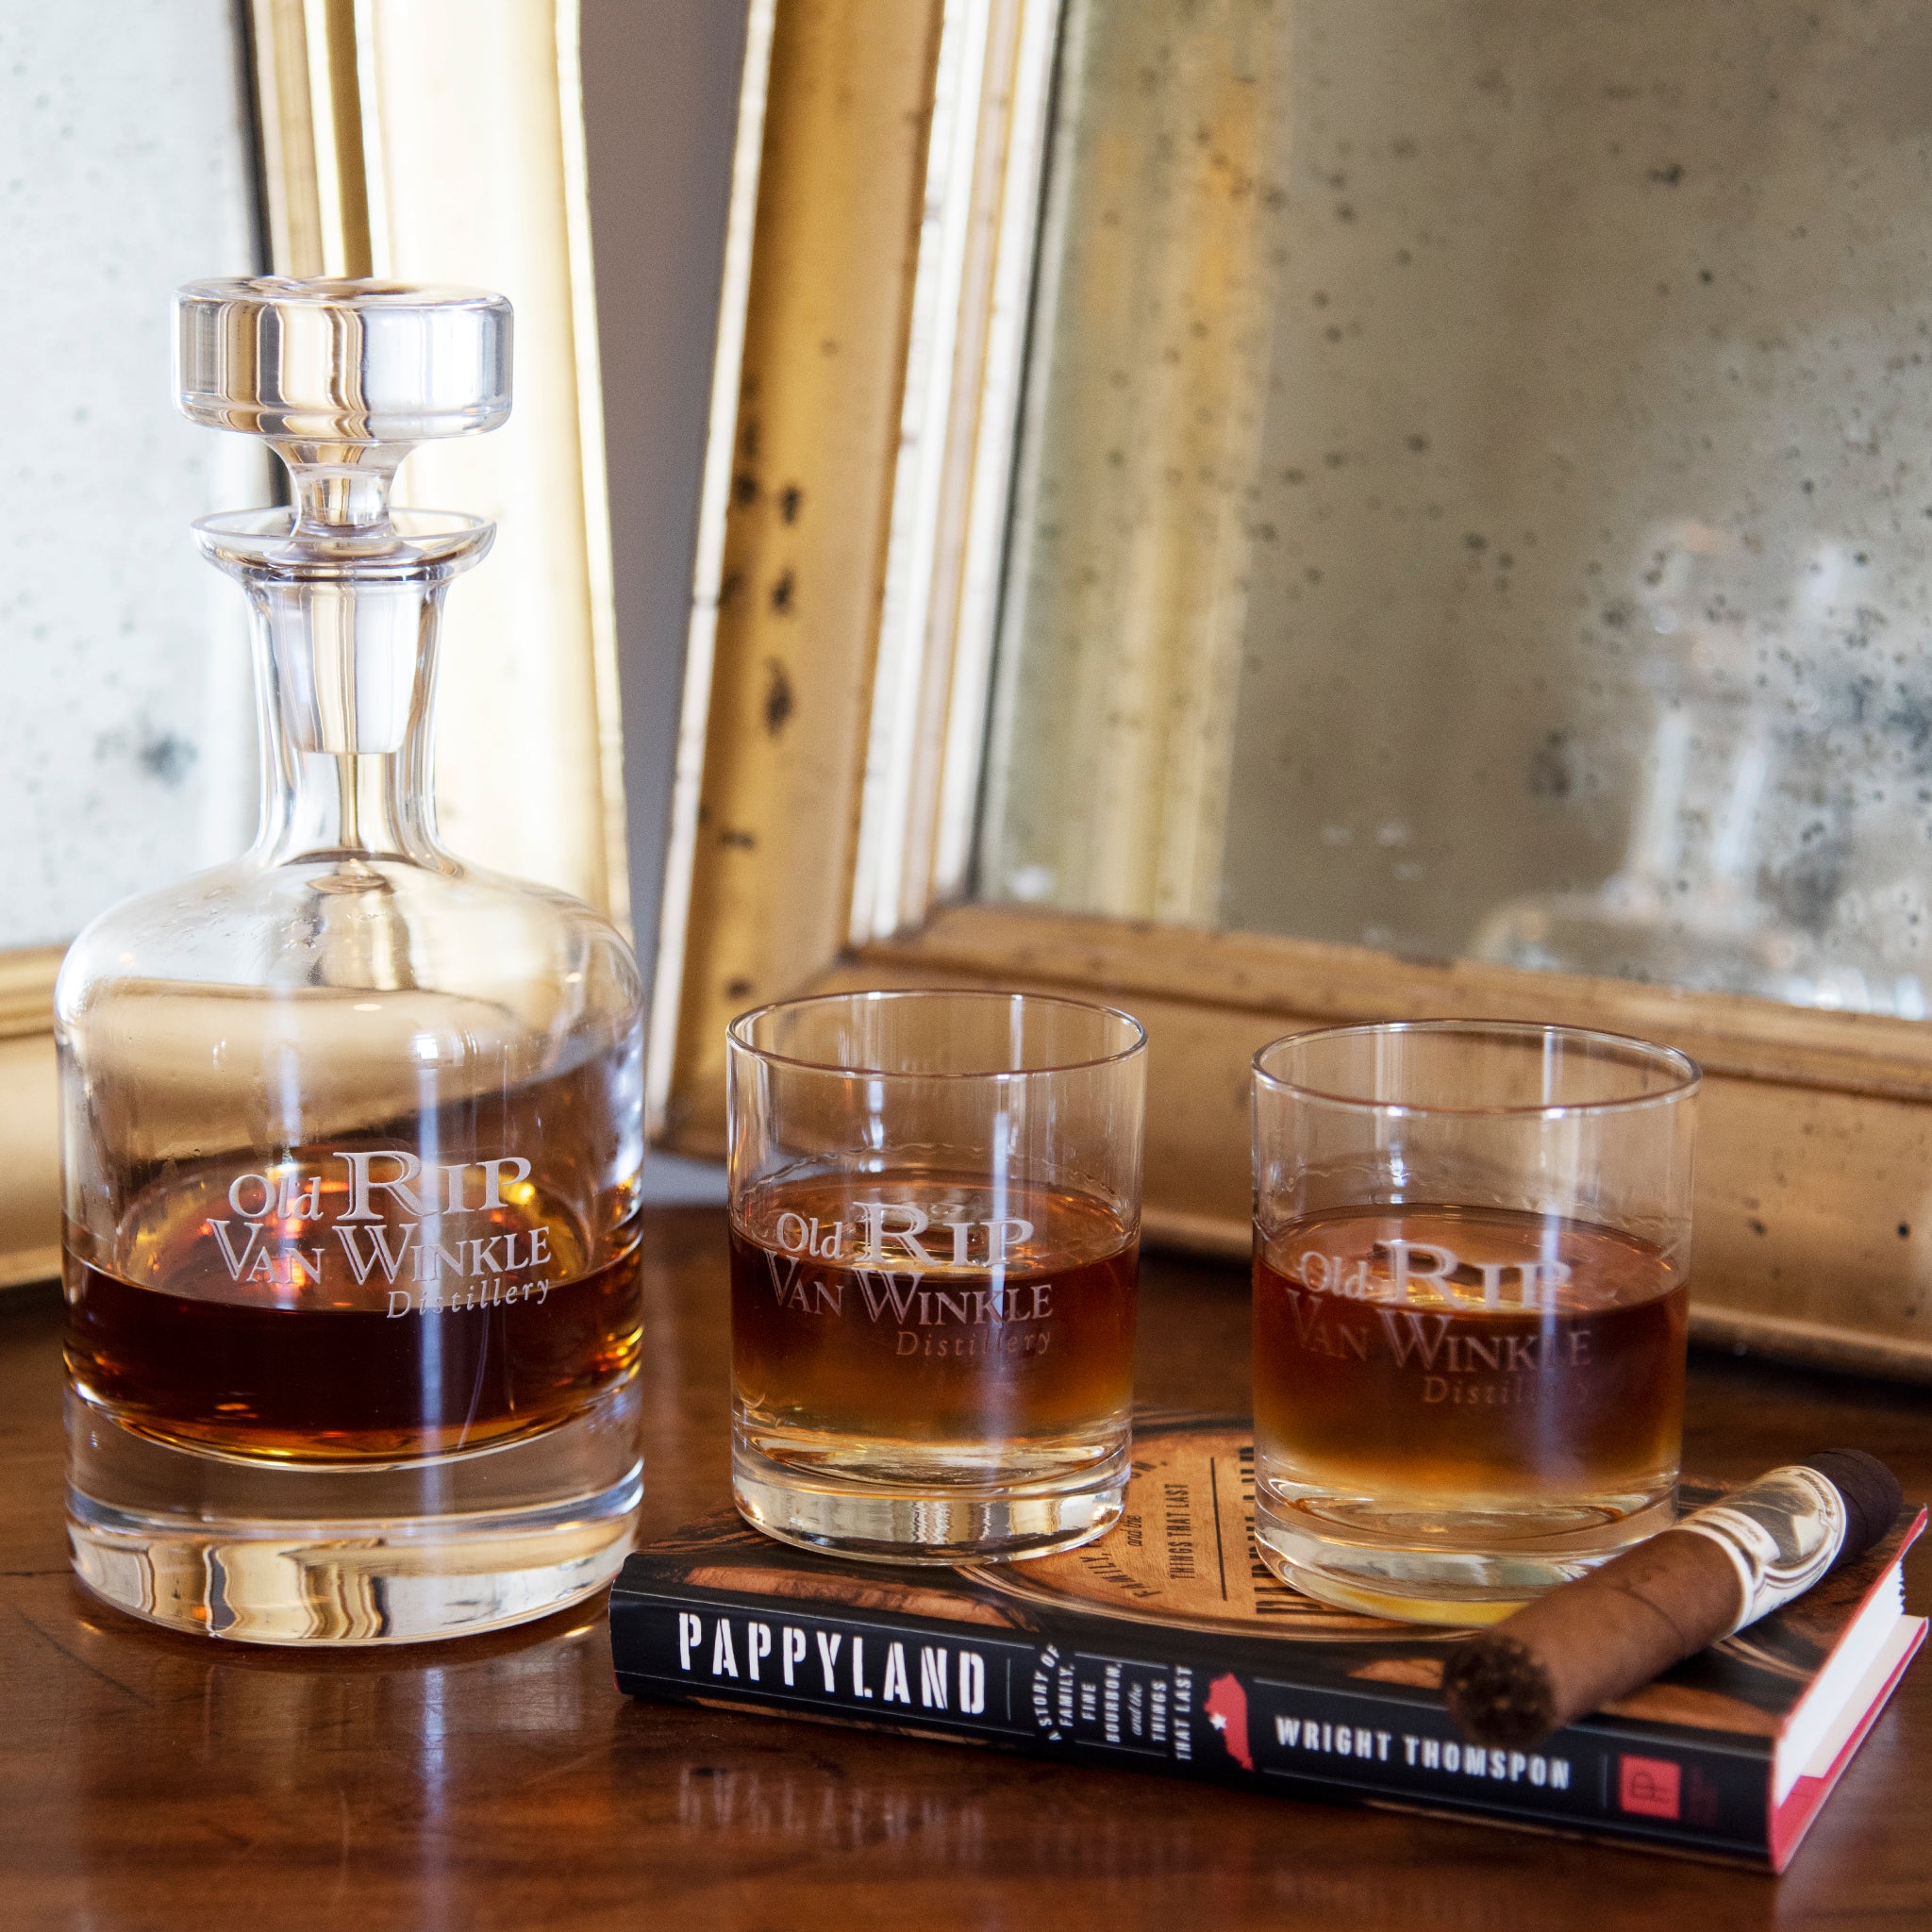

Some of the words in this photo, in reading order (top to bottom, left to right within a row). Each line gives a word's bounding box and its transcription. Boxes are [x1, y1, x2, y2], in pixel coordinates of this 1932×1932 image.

[228, 1174, 325, 1221] Old
[333, 1150, 532, 1221] RIP
[207, 1218, 325, 1285] VAN
[332, 1223, 552, 1286] WINKLE
[775, 1212, 844, 1260] Old
[852, 1201, 1035, 1268] RIP
[387, 1277, 550, 1319] Distillery
[763, 1248, 844, 1318] VAN
[851, 1267, 1054, 1325] WINKLE
[1298, 1250, 1371, 1301] Old
[1375, 1239, 1573, 1310] RIP
[896, 1328, 1051, 1357] Distillery
[1164, 1484, 1190, 1508] LAST
[1166, 1512, 1191, 1537] THAT
[1168, 1541, 1195, 1579] THINGS
[678, 1612, 985, 1714] PAPPYLAND
[1041, 1642, 1059, 1668] OF
[1033, 1670, 1053, 1727] STORY
[1058, 1663, 1074, 1727] FAMILY,
[1080, 1682, 1096, 1721] FINE
[1104, 1662, 1123, 1742] BOURBON,
[1150, 1679, 1166, 1741] THINGS
[1174, 1665, 1192, 1712] LAST
[1048, 1729, 1062, 1741] A
[1174, 1719, 1192, 1760] THAT
[1275, 1716, 1392, 1760] WRIGHT
[1403, 1734, 1571, 1790] THOMSPON
